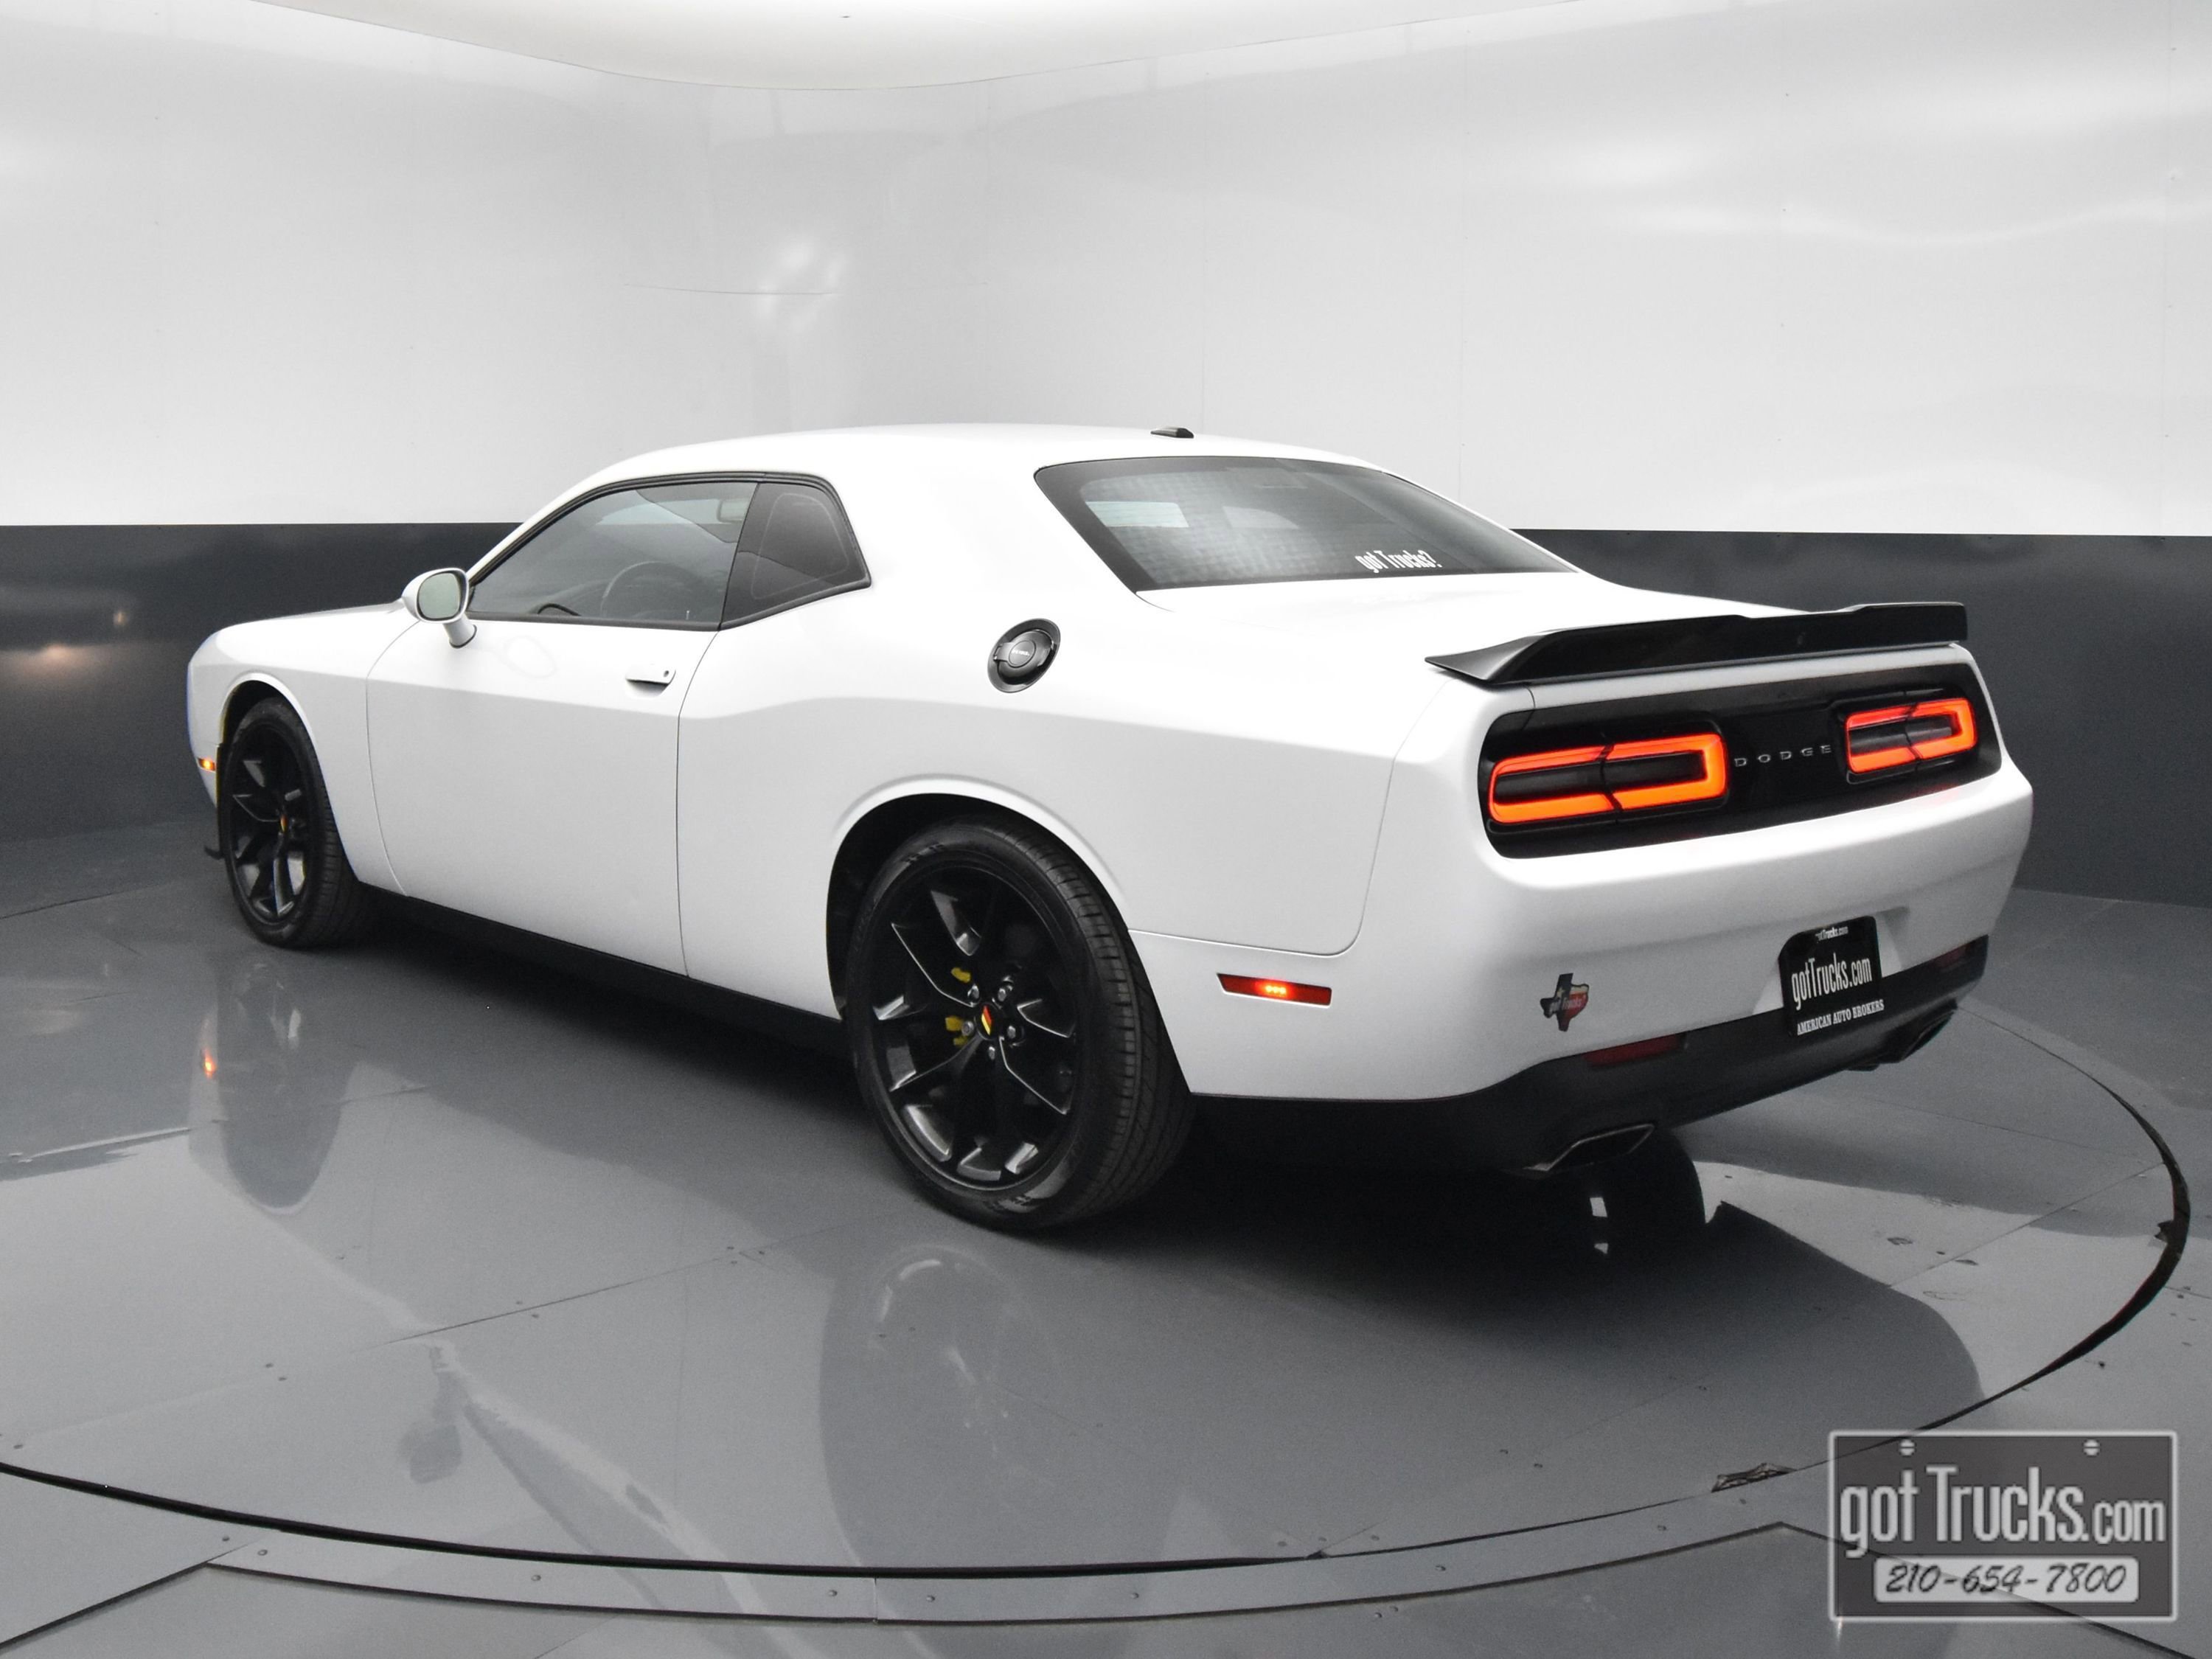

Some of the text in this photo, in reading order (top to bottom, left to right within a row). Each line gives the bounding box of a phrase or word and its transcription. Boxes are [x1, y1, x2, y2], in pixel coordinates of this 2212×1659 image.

[1354, 549, 1443, 574] got Trucks?
[1733, 744, 1832, 768] DODGE
[1791, 952, 1873, 1011] gotTrucks.com
[1797, 998, 1885, 1036] AMERICAN AUTO BROKERS
